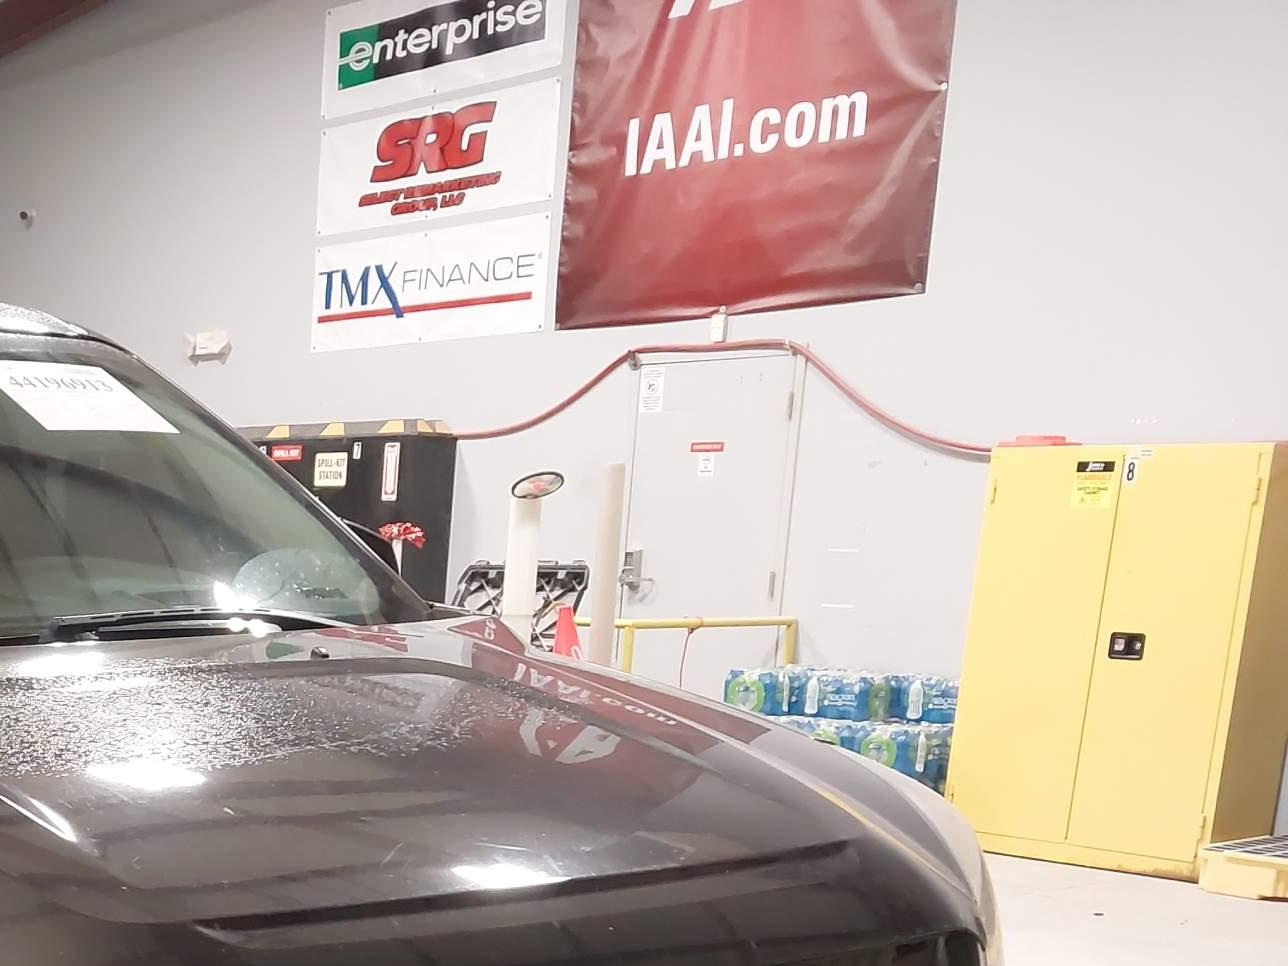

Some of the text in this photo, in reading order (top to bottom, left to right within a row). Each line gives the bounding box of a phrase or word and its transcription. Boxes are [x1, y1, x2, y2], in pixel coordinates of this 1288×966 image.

[341, 0, 542, 70] enterprise
[370, 100, 497, 183] SRG
[624, 89, 869, 177] IAAI.com
[319, 254, 536, 318] TMX FINANCE
[8, 374, 114, 393] 44196913
[355, 443, 361, 457] 7
[317, 458, 346, 467] SPILL-KIT
[1126, 462, 1136, 481] 8
[318, 471, 343, 480] STATION
